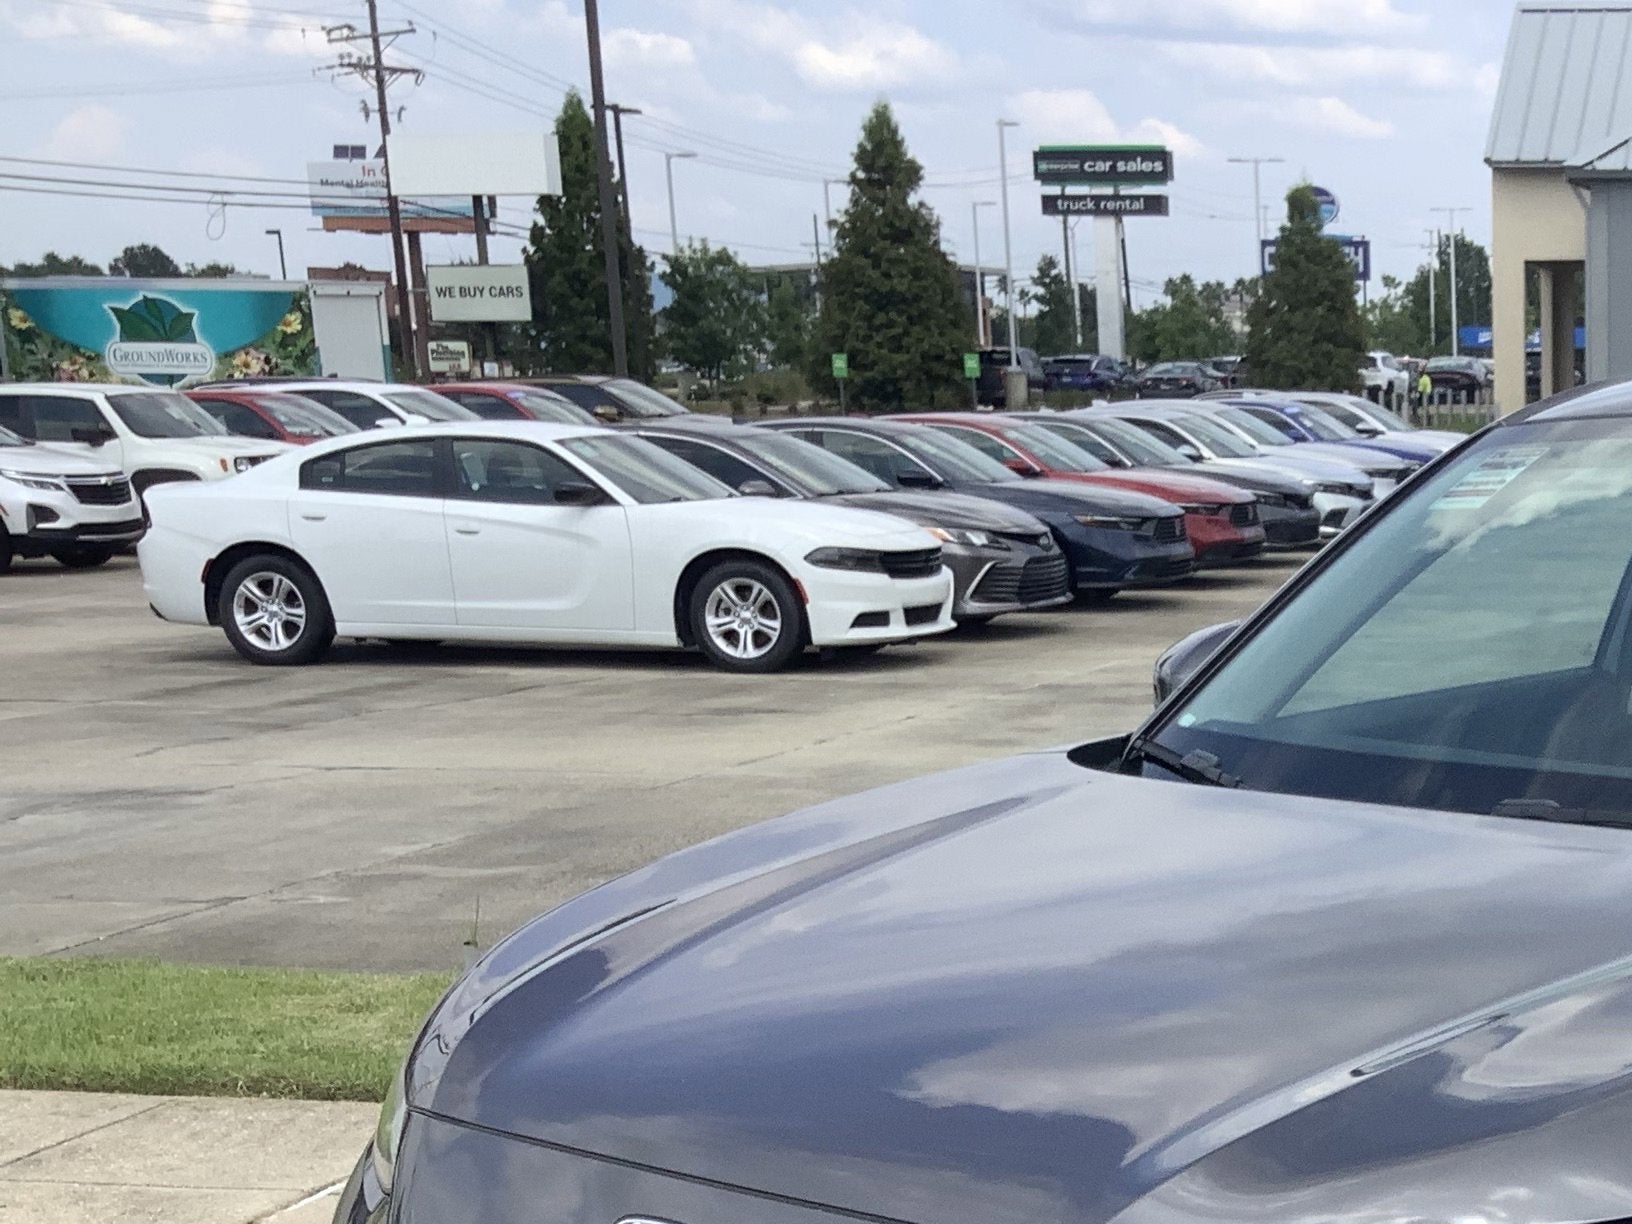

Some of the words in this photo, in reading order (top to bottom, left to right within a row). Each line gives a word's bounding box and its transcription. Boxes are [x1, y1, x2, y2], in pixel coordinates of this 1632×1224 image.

[1083, 160, 1113, 172] car
[1116, 156, 1164, 172] sales
[1057, 197, 1096, 210] truck
[1100, 197, 1144, 210] rental
[435, 286, 456, 298] WE
[459, 286, 485, 298] BUY
[489, 286, 524, 298] CARS
